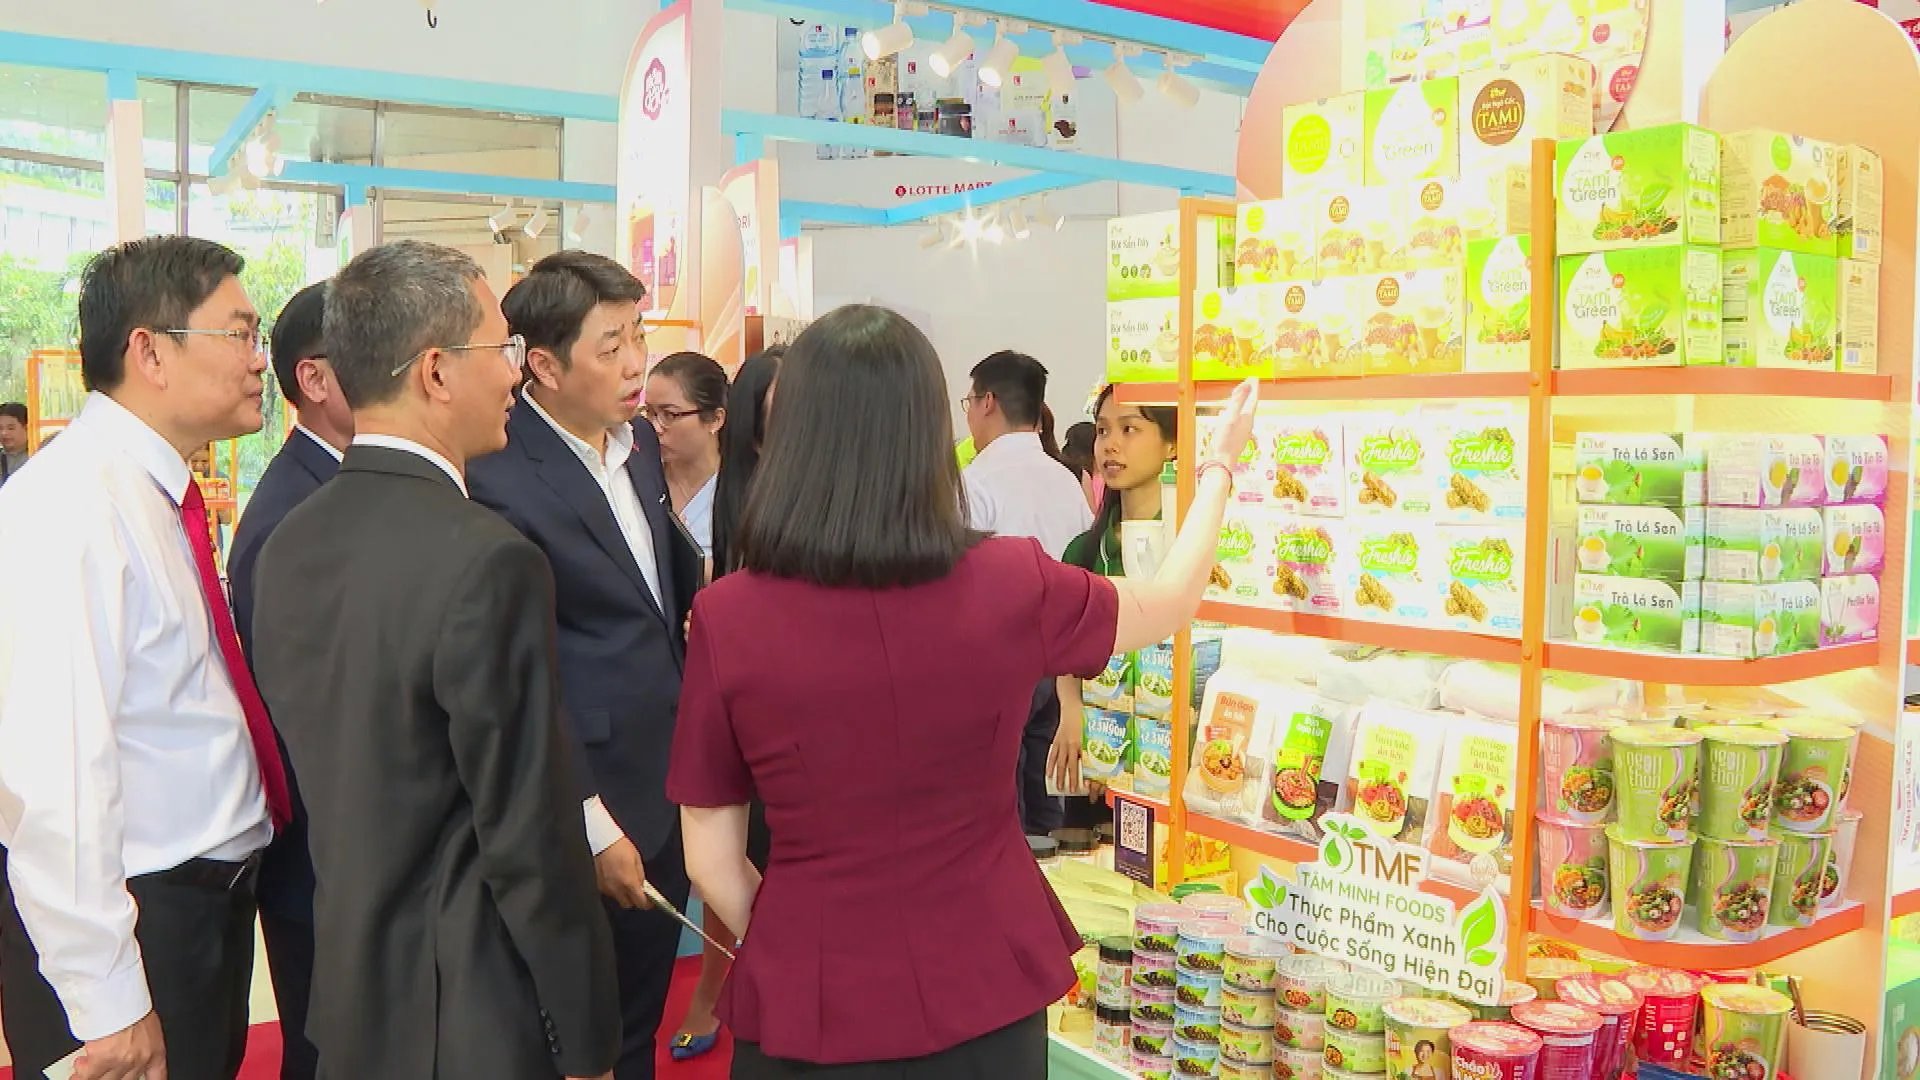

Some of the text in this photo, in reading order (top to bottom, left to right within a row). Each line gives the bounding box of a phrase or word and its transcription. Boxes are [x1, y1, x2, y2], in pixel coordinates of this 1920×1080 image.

[1479, 107, 1518, 129] TAMI
[909, 184, 951, 197] LOTTE
[1570, 187, 1616, 202] Green
[1573, 304, 1617, 319] Green
[1770, 301, 1801, 318] Green
[1278, 438, 1325, 461] Freshie
[1364, 440, 1416, 464] Freshie
[1452, 440, 1511, 466] Freshie
[1612, 447, 1631, 462] Trà
[1634, 447, 1648, 461] Lá
[1614, 519, 1633, 533] Trà
[1637, 520, 1650, 534] Lá
[1279, 537, 1327, 559] Freshie
[1361, 543, 1415, 567] Freshie
[1452, 549, 1509, 574] Freshie
[1611, 591, 1630, 606] Trà
[1633, 592, 1647, 607] Lá
[1352, 841, 1422, 887] TMF
[1301, 869, 1446, 924] TÂM MINH FOODS
[1288, 893, 1457, 956] Thực Phẩm Xanh
[1254, 911, 1289, 935] Cho
[1294, 922, 1340, 953] Cuộc
[1346, 937, 1396, 973] Sống
[1404, 953, 1450, 986] Hiện
[1457, 969, 1494, 998] Đại
